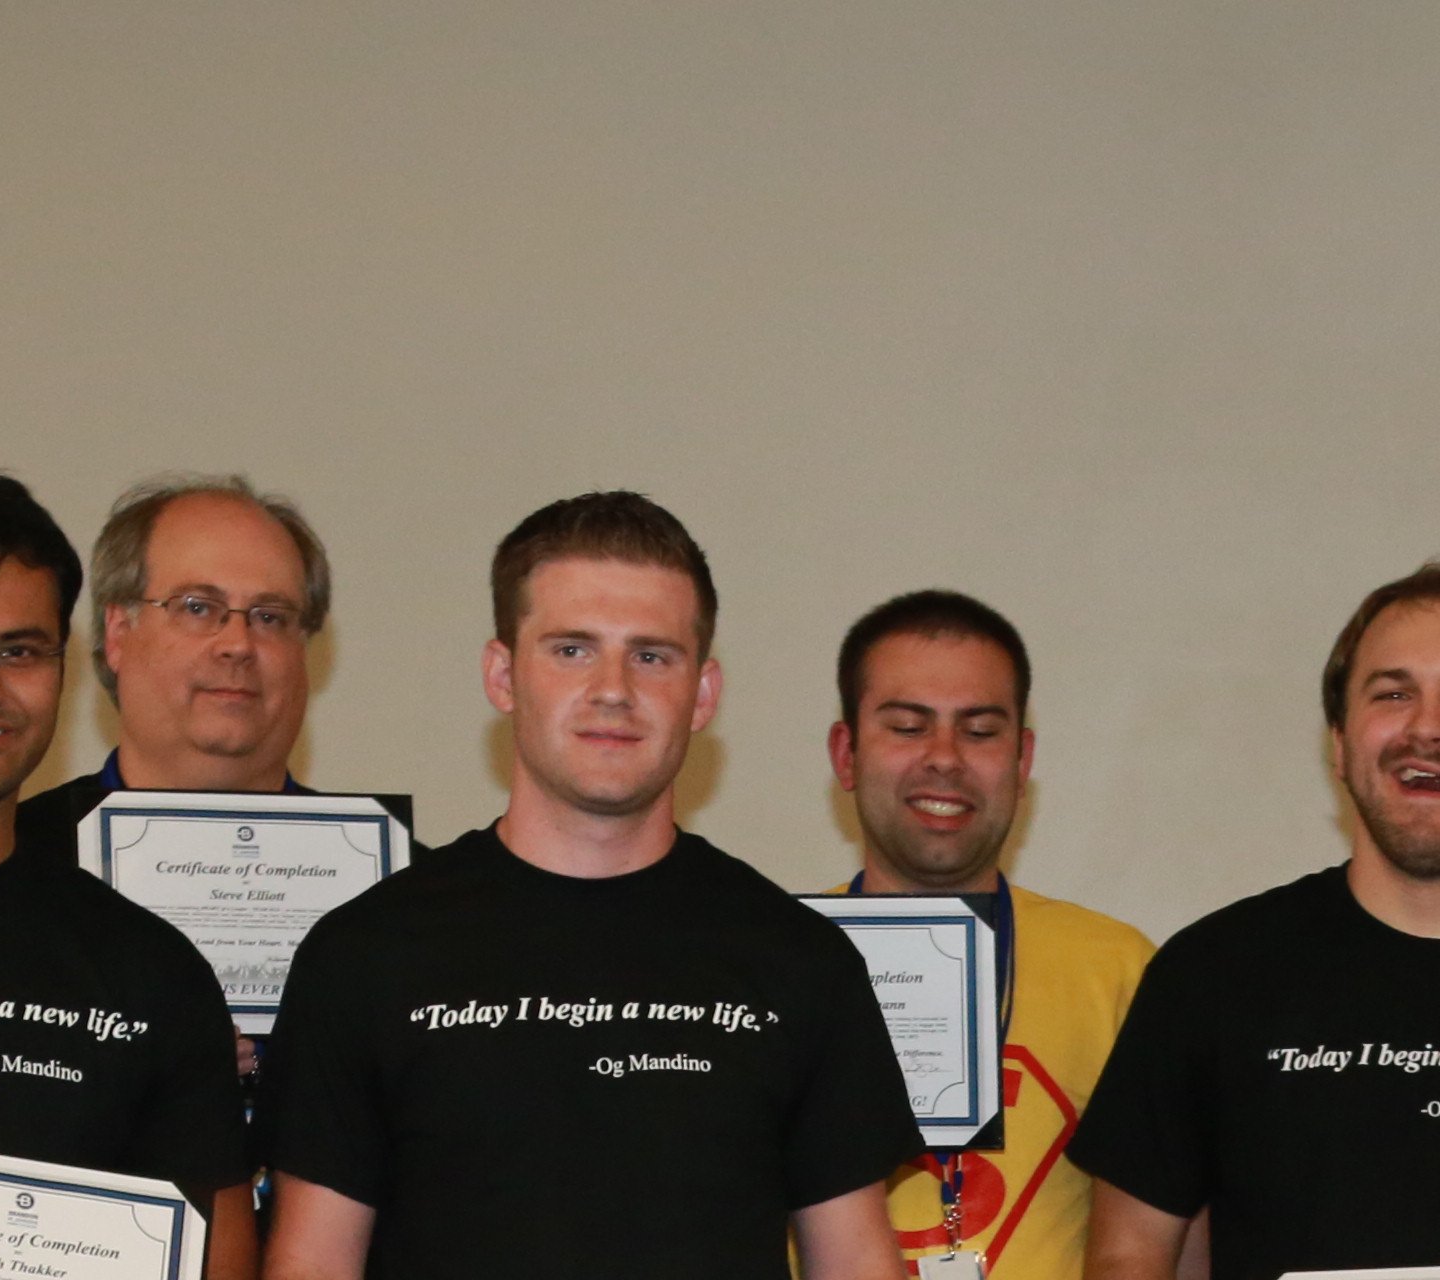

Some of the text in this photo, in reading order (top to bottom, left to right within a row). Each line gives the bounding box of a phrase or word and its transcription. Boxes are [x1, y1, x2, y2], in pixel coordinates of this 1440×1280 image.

[23, 1004, 79, 1027] new
[516, 998, 531, 1020] I
[539, 997, 612, 1027] begin
[622, 1003, 639, 1018] a
[648, 1004, 705, 1021] new
[589, 1054, 711, 1077] -Og Mandino
[1358, 1044, 1373, 1065] I
[2, 1055, 82, 1082] Mandino
